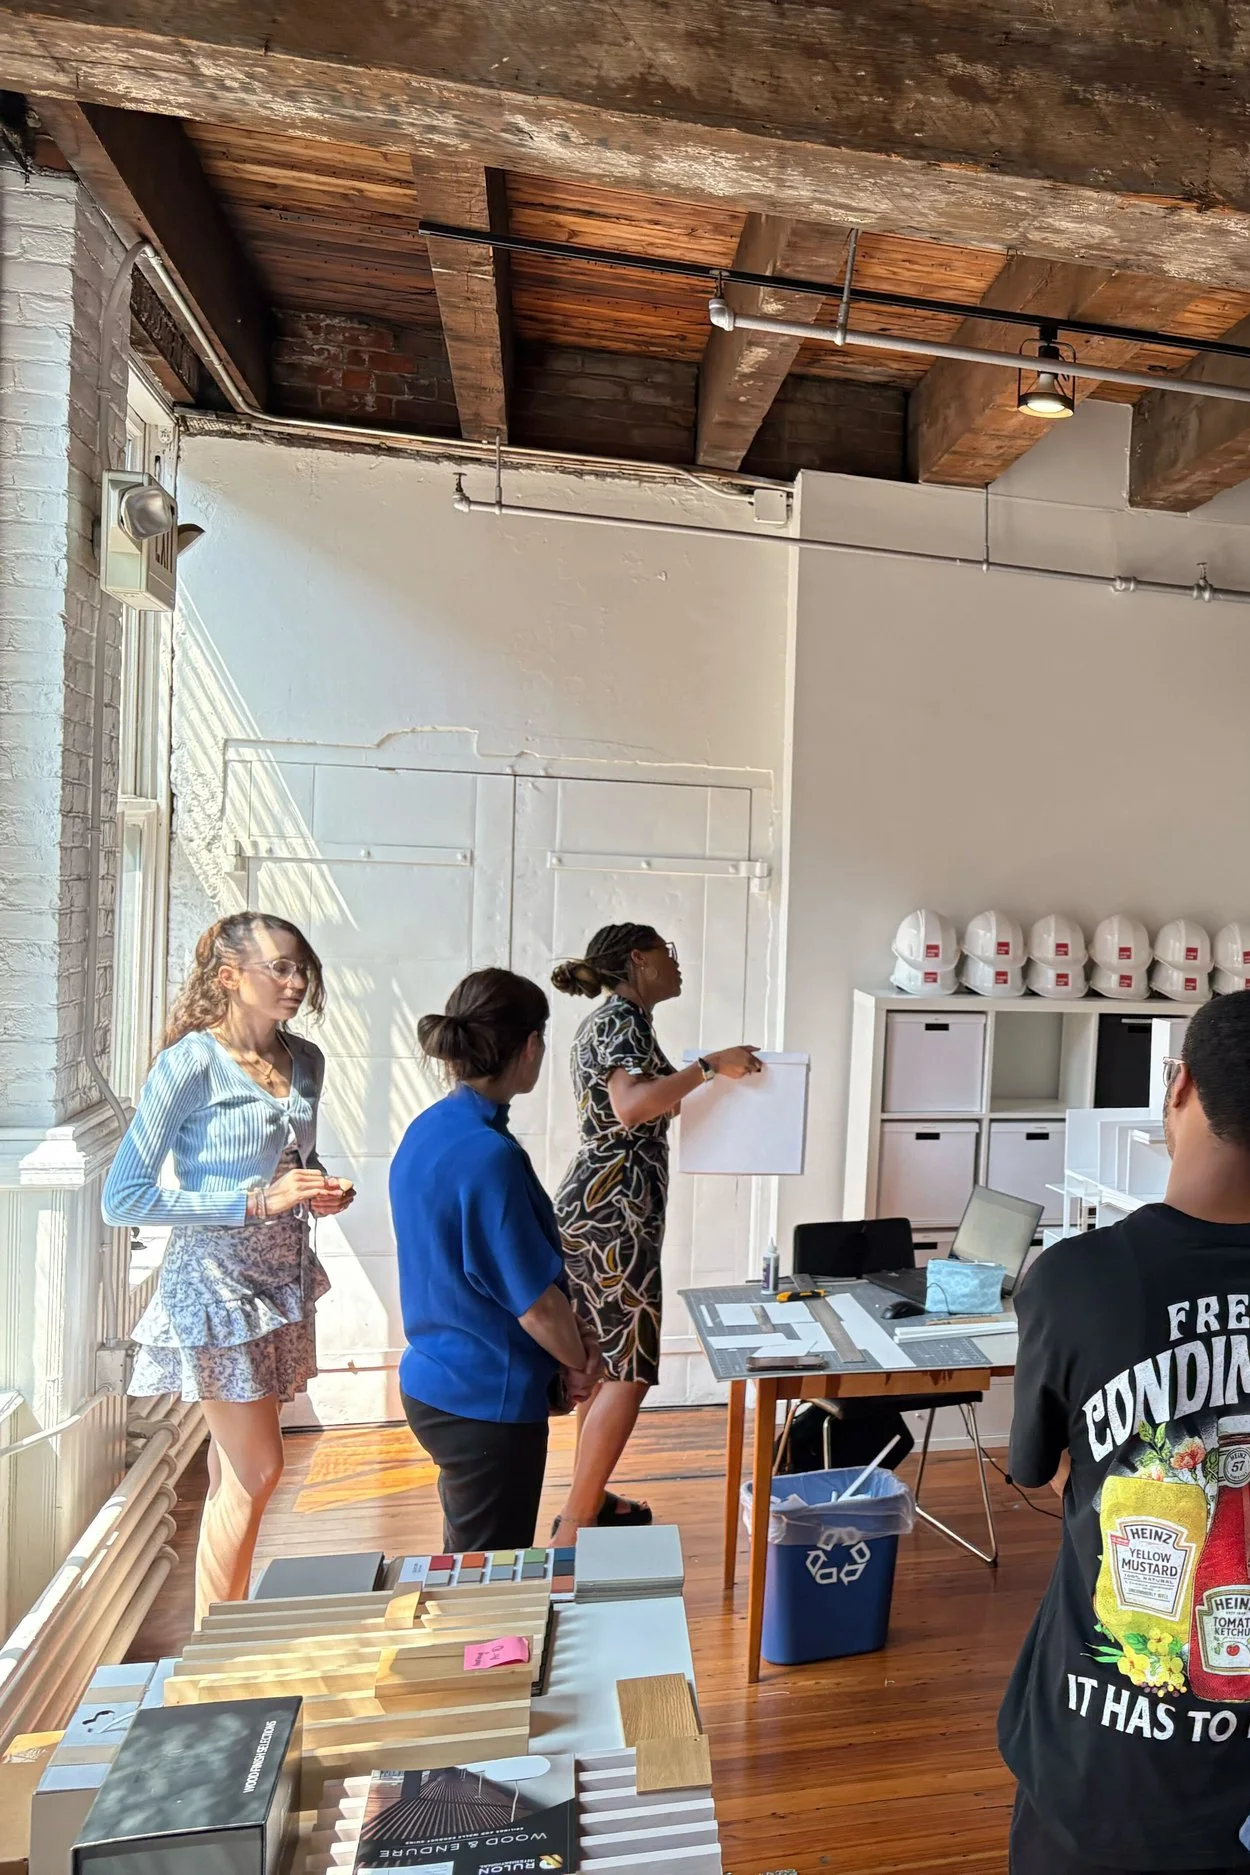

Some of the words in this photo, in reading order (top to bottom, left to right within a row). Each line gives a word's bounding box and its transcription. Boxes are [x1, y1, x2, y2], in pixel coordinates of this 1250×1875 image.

[1231, 1460, 1246, 1473] 57
[1129, 1527, 1173, 1545] HEINZ
[1129, 1547, 1172, 1563] YELLOW
[1121, 1558, 1178, 1577] MUSTARD
[1142, 1576, 1174, 1585] NATURAL
[1067, 1673, 1099, 1718] IT
[1101, 1683, 1176, 1741] HAS
[1187, 1710, 1238, 1742] TO
[256, 1720, 277, 1753] SELECTIONS
[249, 1752, 267, 1772] FINISH
[242, 1771, 260, 1794] WOOD
[468, 1841, 479, 1849] &
[485, 1832, 547, 1846] WOOD
[379, 1843, 460, 1858] ENDURE
[478, 1862, 535, 1875] RULON
